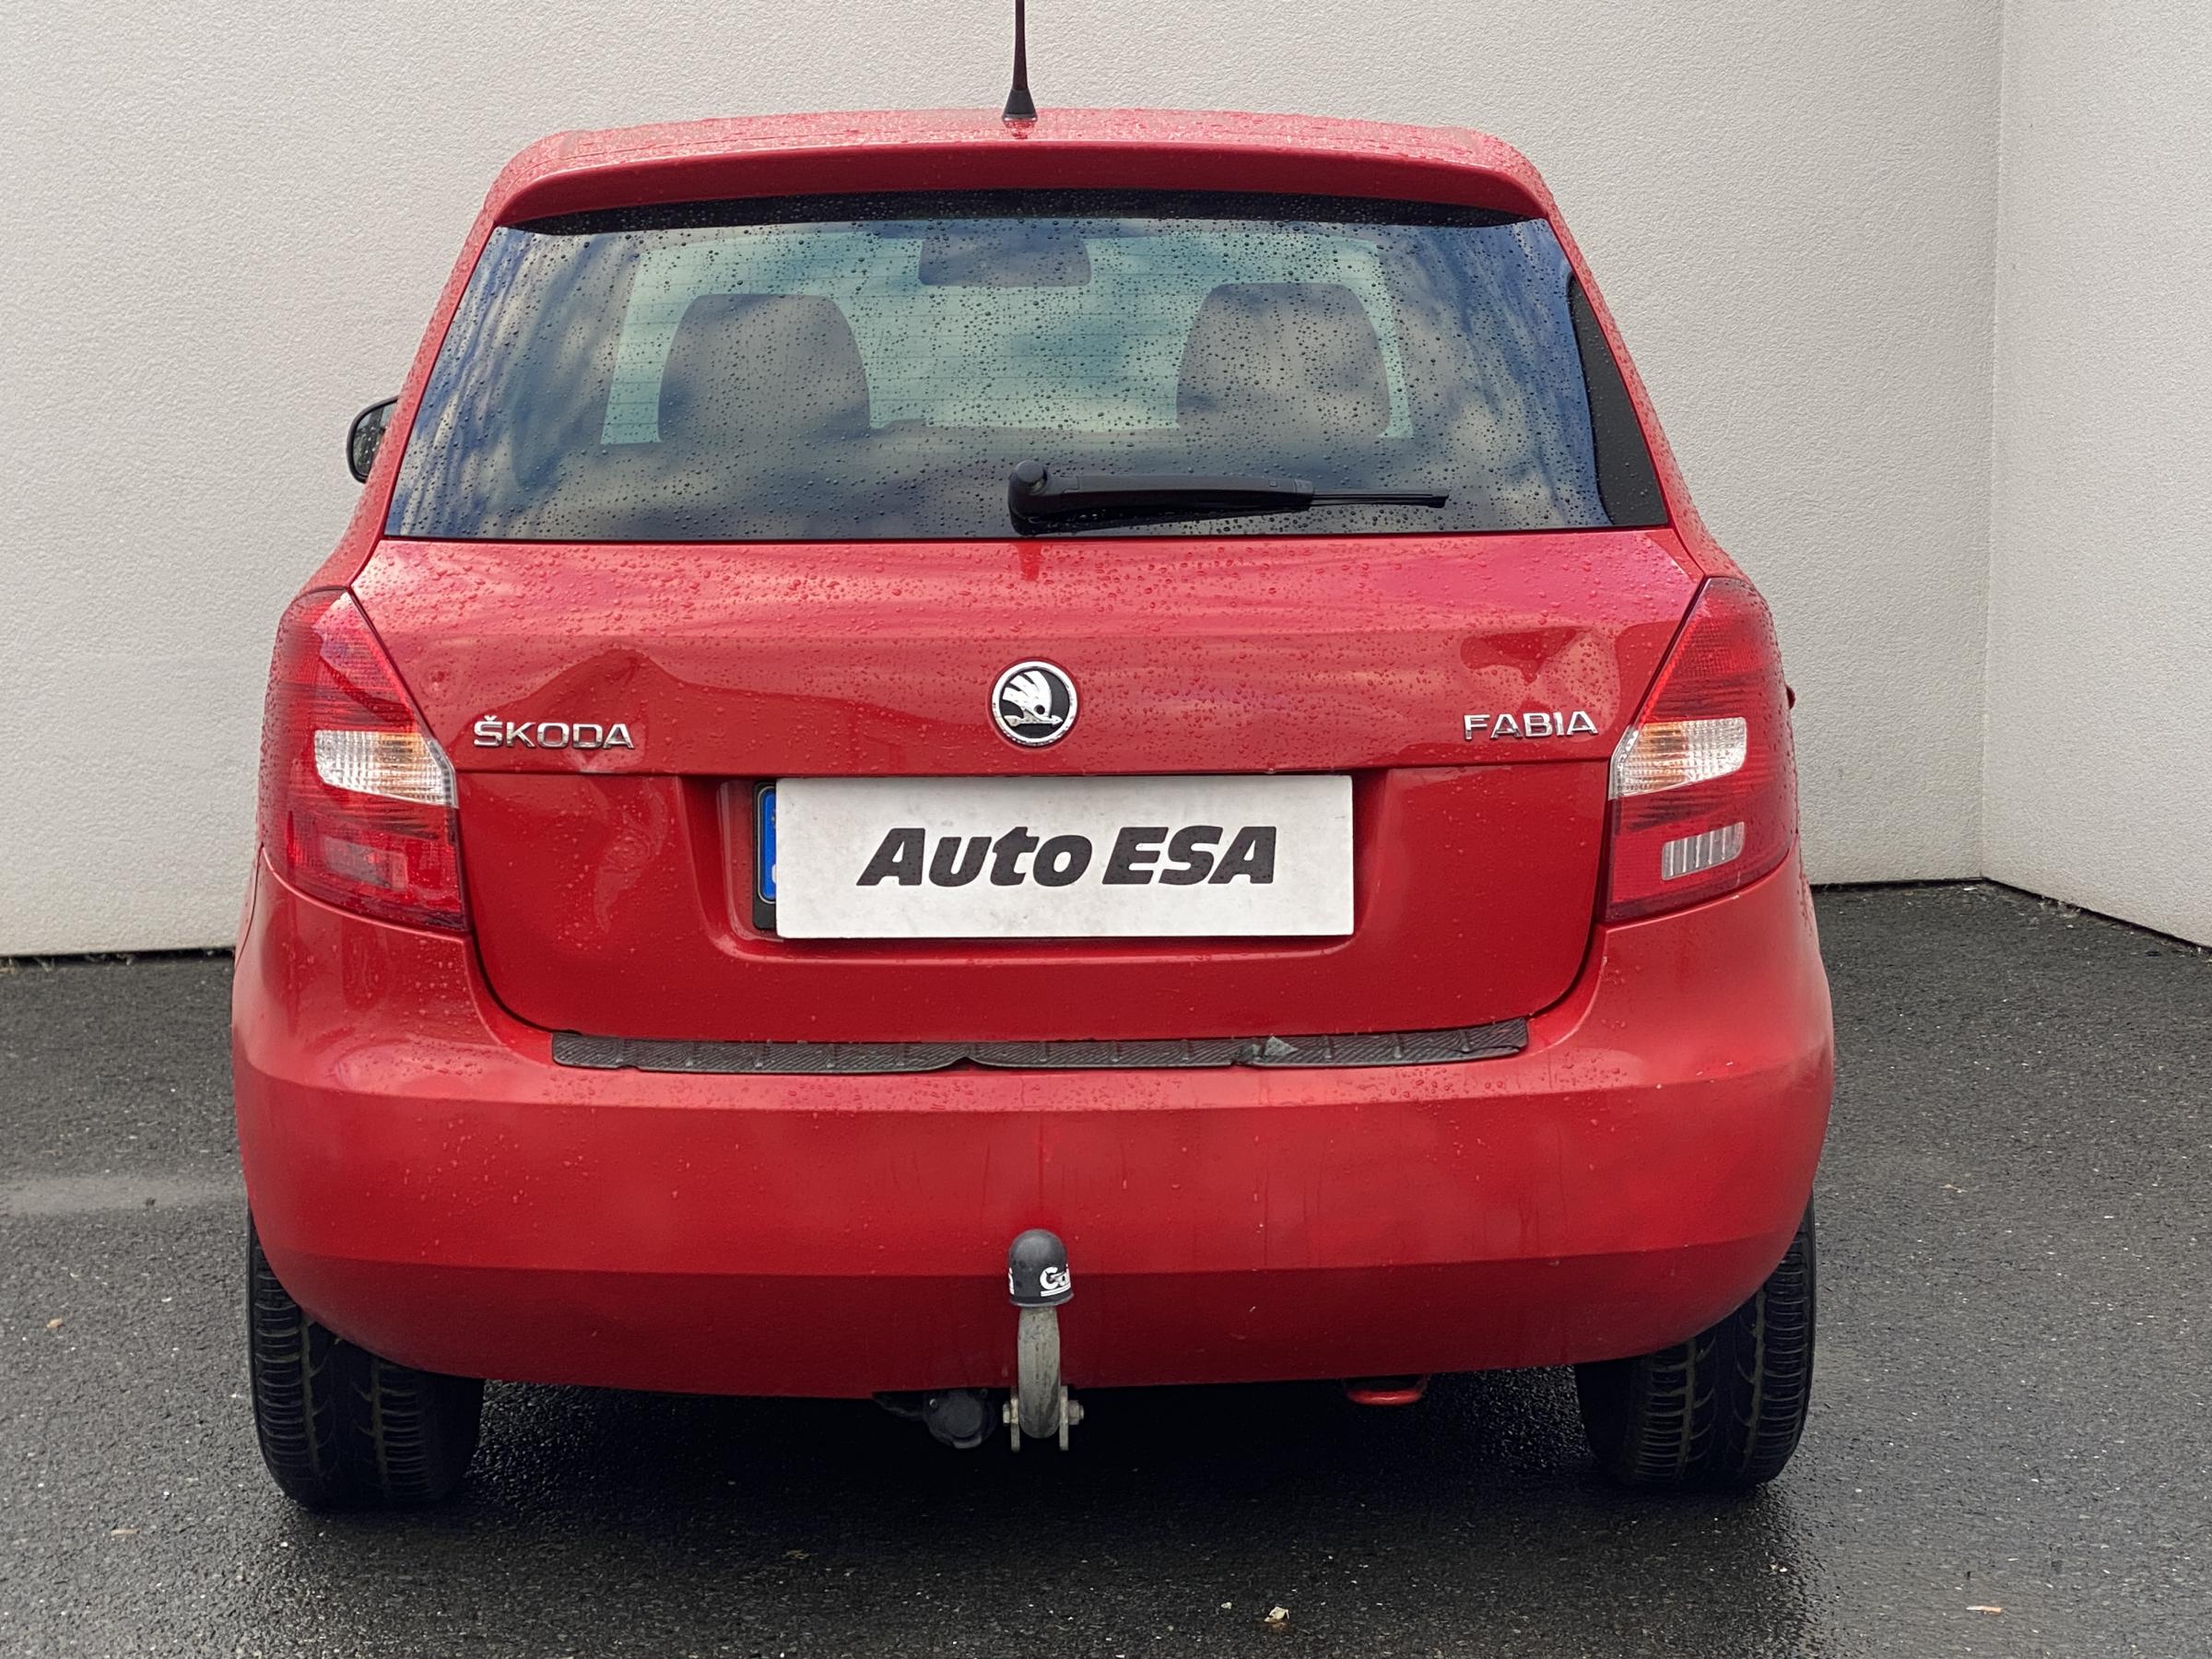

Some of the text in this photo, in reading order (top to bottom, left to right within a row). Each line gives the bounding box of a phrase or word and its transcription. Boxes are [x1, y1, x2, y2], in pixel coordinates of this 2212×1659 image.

[474, 715, 634, 749] ŠKODA
[1464, 712, 1598, 740] FABIA
[856, 826, 1277, 887] Auto ESA
